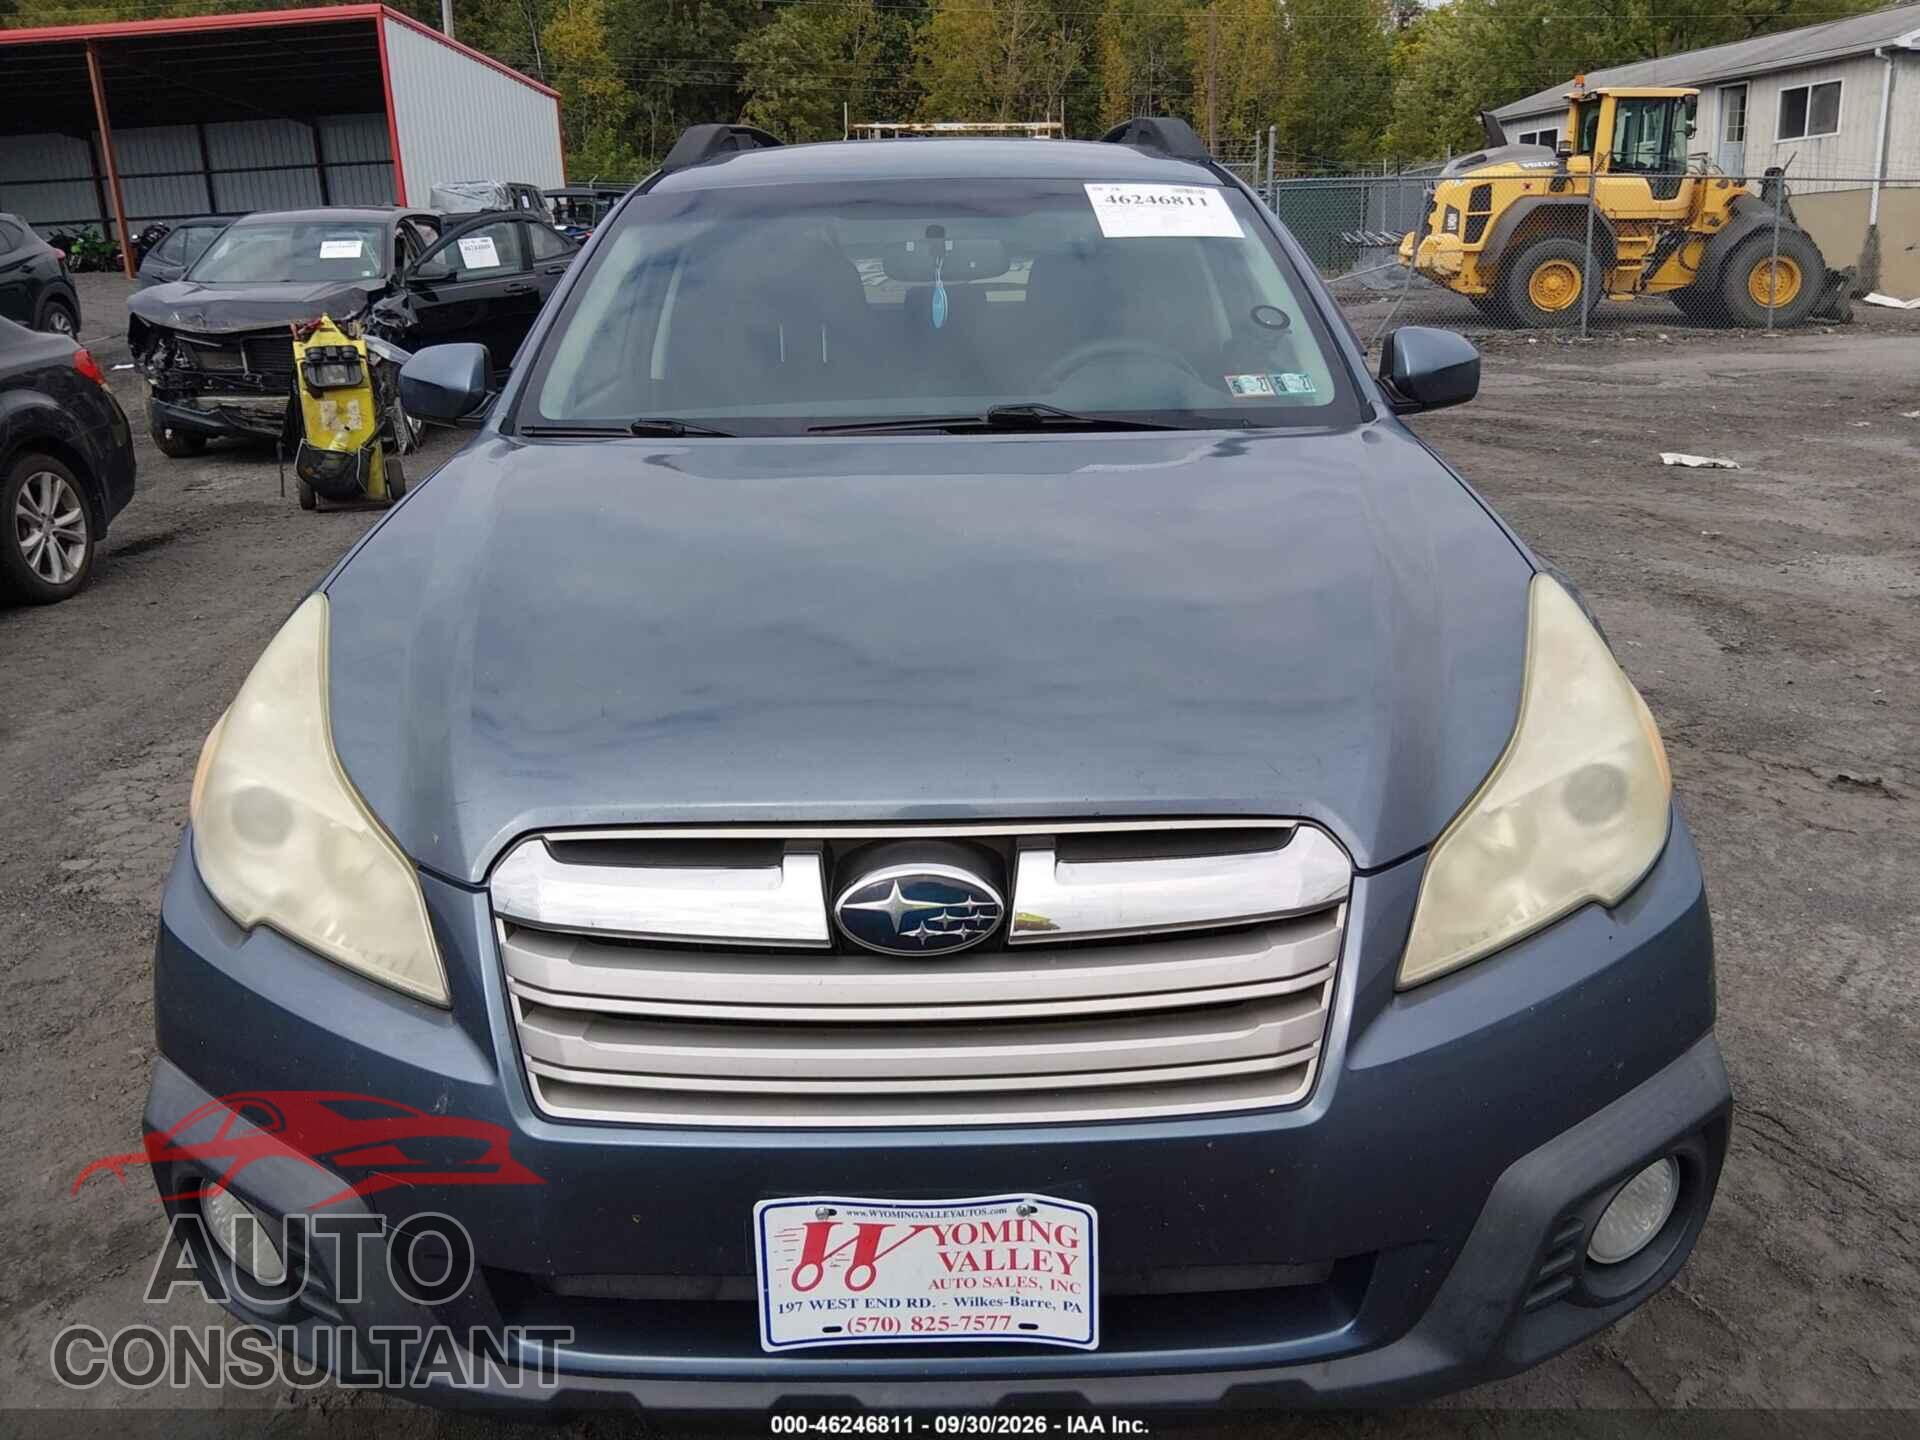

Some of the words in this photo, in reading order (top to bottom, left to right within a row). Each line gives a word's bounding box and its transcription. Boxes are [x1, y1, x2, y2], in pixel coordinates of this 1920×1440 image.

[1105, 194, 1208, 207] 46246811
[937, 1248, 1079, 1276] VALLEY
[928, 1276, 977, 1290] AUTO
[982, 1276, 1043, 1291] SALES,
[1050, 1278, 1082, 1295] INC
[778, 1301, 803, 1315] 197
[809, 1298, 859, 1310] WEST
[864, 1298, 901, 1309] END
[906, 1298, 936, 1309] RD.
[954, 1296, 1057, 1311] Wilkes-Barre,
[1063, 1300, 1083, 1314] PA
[847, 1316, 901, 1334] (570)
[911, 1315, 1012, 1332] 825-7577
